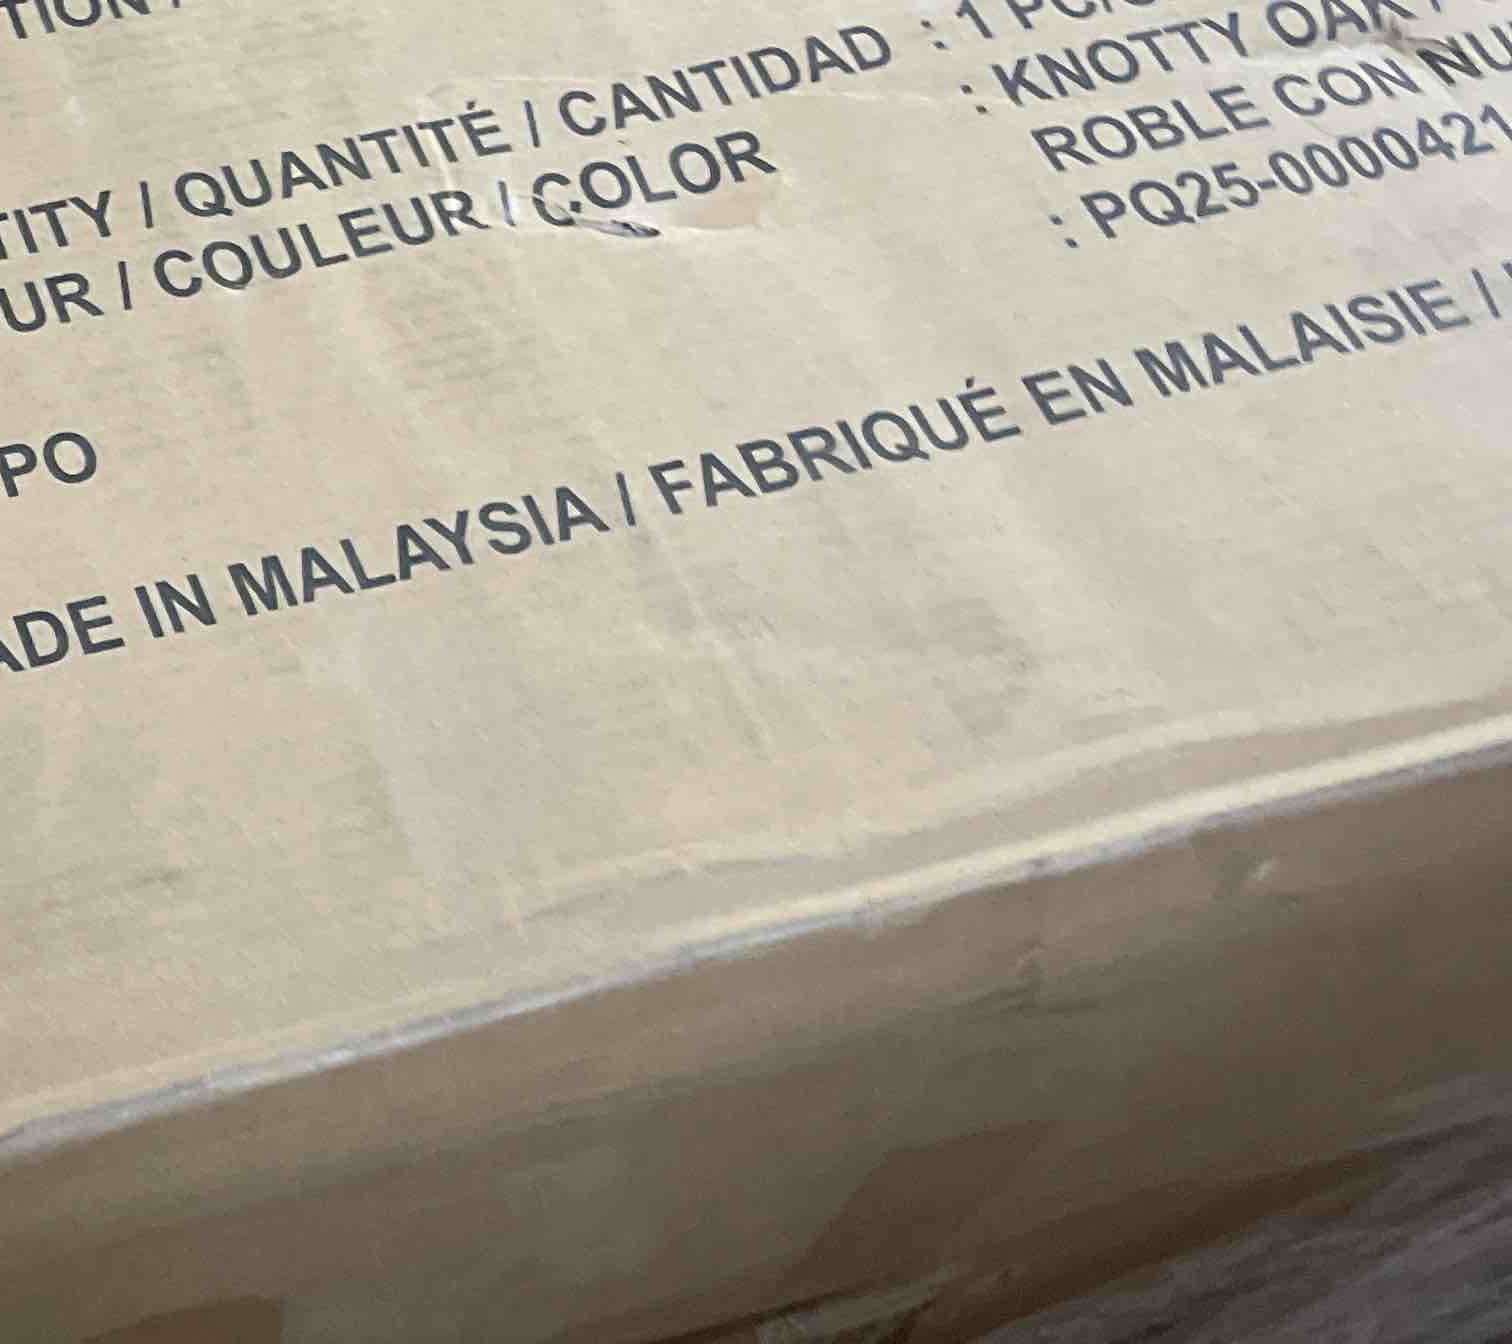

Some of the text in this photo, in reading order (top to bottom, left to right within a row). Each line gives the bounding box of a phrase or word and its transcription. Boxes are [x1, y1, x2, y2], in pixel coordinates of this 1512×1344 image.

[138, 179, 156, 231] /
[173, 99, 514, 219] QUANTITÉ
[522, 98, 542, 150] /
[557, 24, 893, 138] CANTIDAD
[989, 10, 1250, 108] KNOTTY
[1029, 22, 1512, 173] ROBLE CON NU
[116, 259, 134, 312] /
[152, 189, 493, 299] COULEUR
[530, 129, 779, 229] COLOR
[132, 572, 219, 640] IN
[225, 484, 612, 618] MALAYSIA
[614, 470, 638, 528] /
[646, 375, 1024, 516] FABRIQUÉ
[1019, 357, 1135, 427] EN
[1132, 278, 1473, 399] MALAISIE
